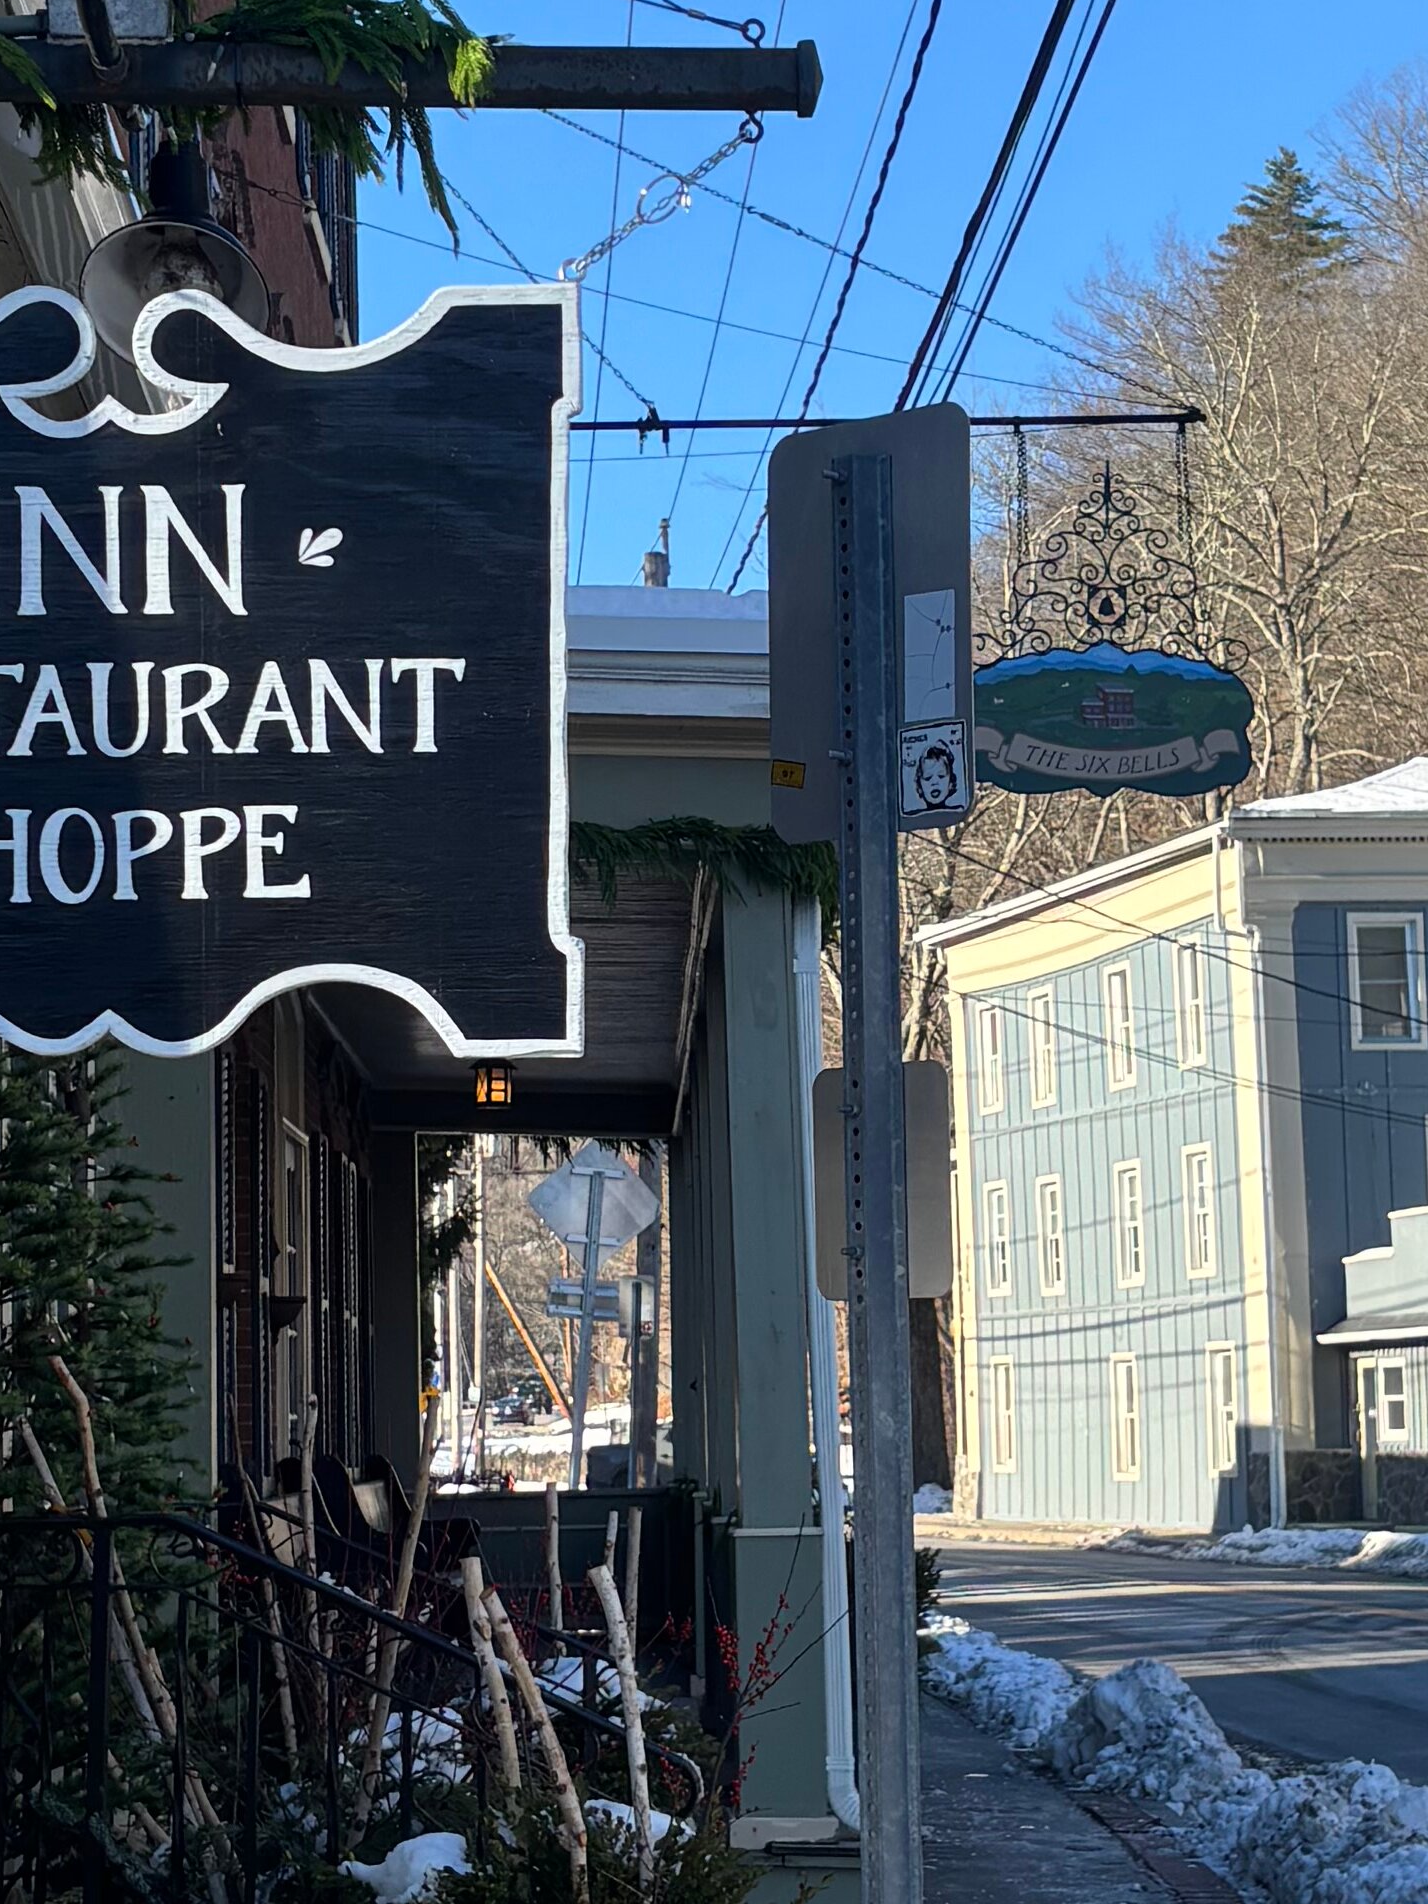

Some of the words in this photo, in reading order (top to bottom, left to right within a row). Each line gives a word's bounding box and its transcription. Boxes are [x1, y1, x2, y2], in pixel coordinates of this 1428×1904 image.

[1026, 745, 1070, 771] THE
[1075, 753, 1112, 775] SIX
[1117, 747, 1180, 775] BELLS
